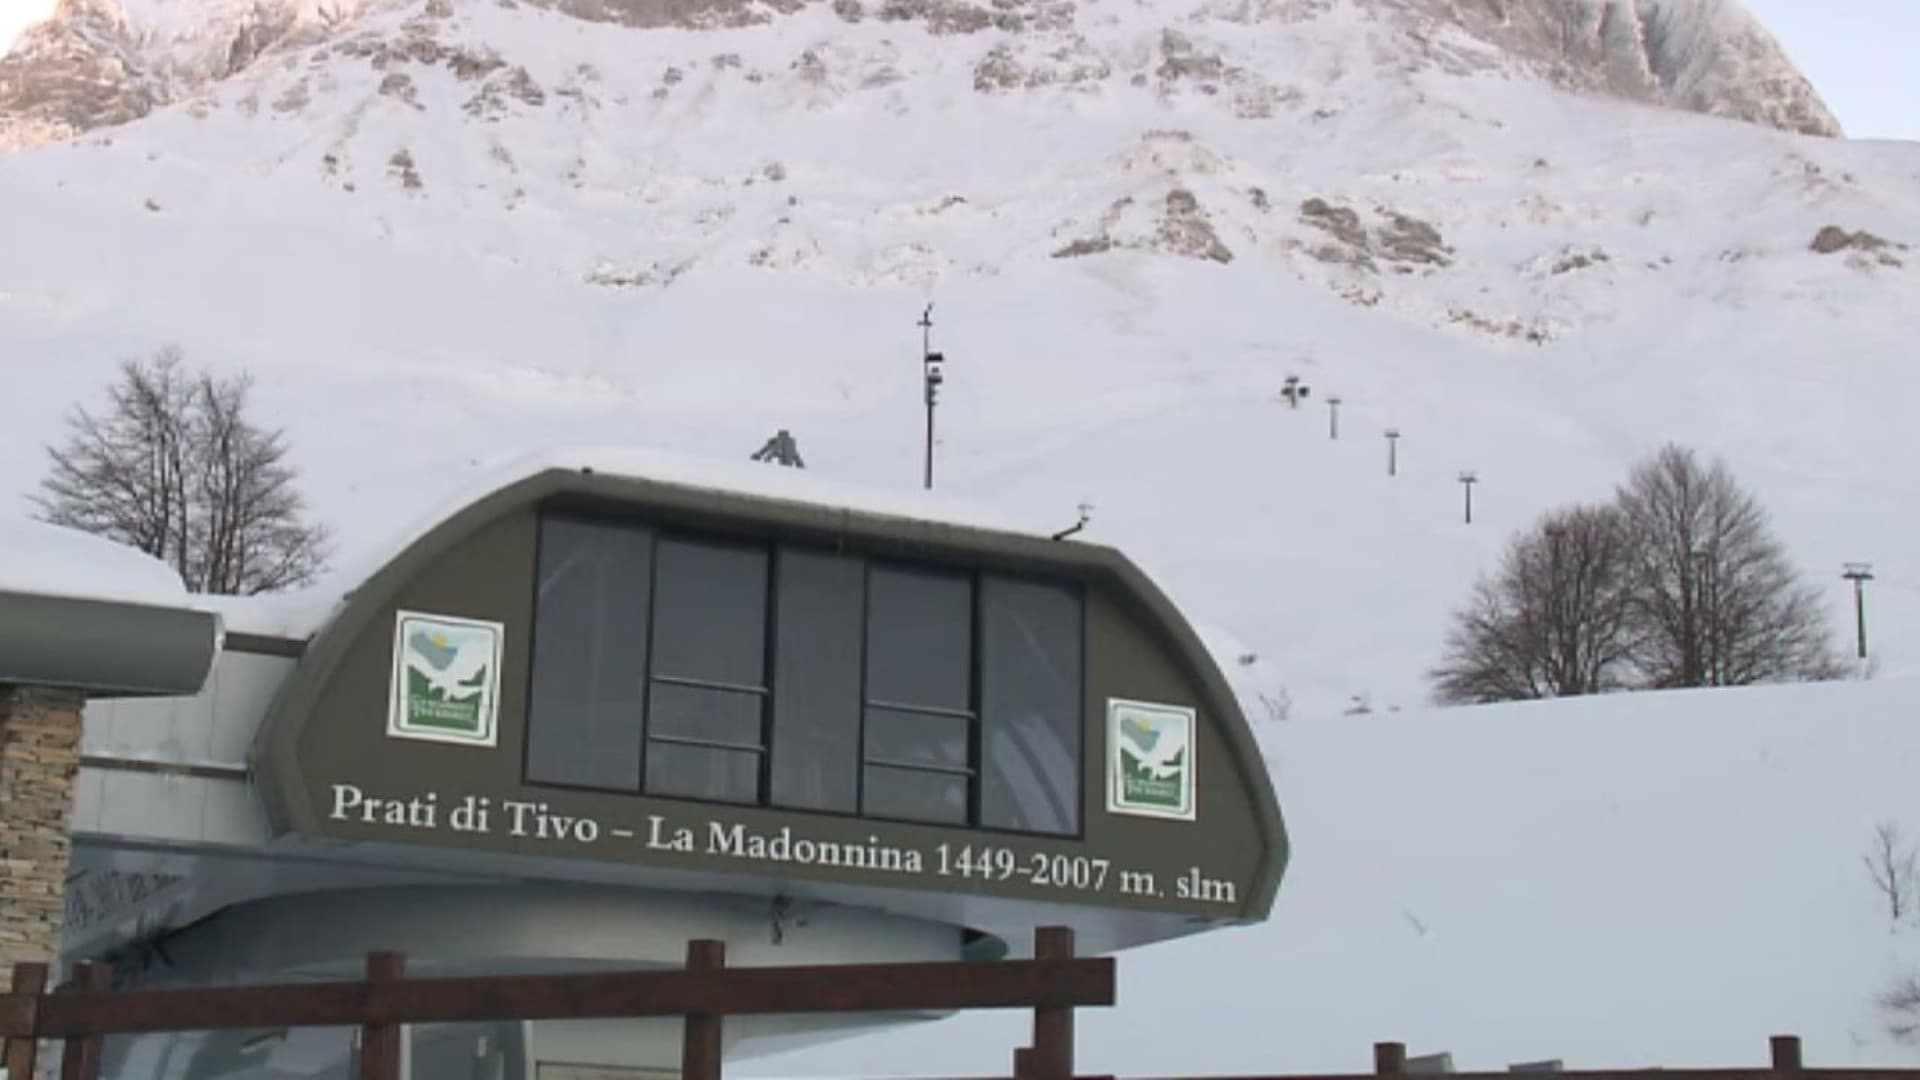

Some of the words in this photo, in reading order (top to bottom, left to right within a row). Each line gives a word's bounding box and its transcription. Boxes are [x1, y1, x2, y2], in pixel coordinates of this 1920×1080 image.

[330, 784, 437, 827] Prati
[450, 796, 490, 832] di
[503, 801, 598, 842] Tivo
[646, 815, 694, 852] La
[707, 821, 923, 873] Madonnina
[936, 843, 1110, 891] 1449-2007
[1120, 869, 1165, 897] m.
[1177, 866, 1236, 903] slm
